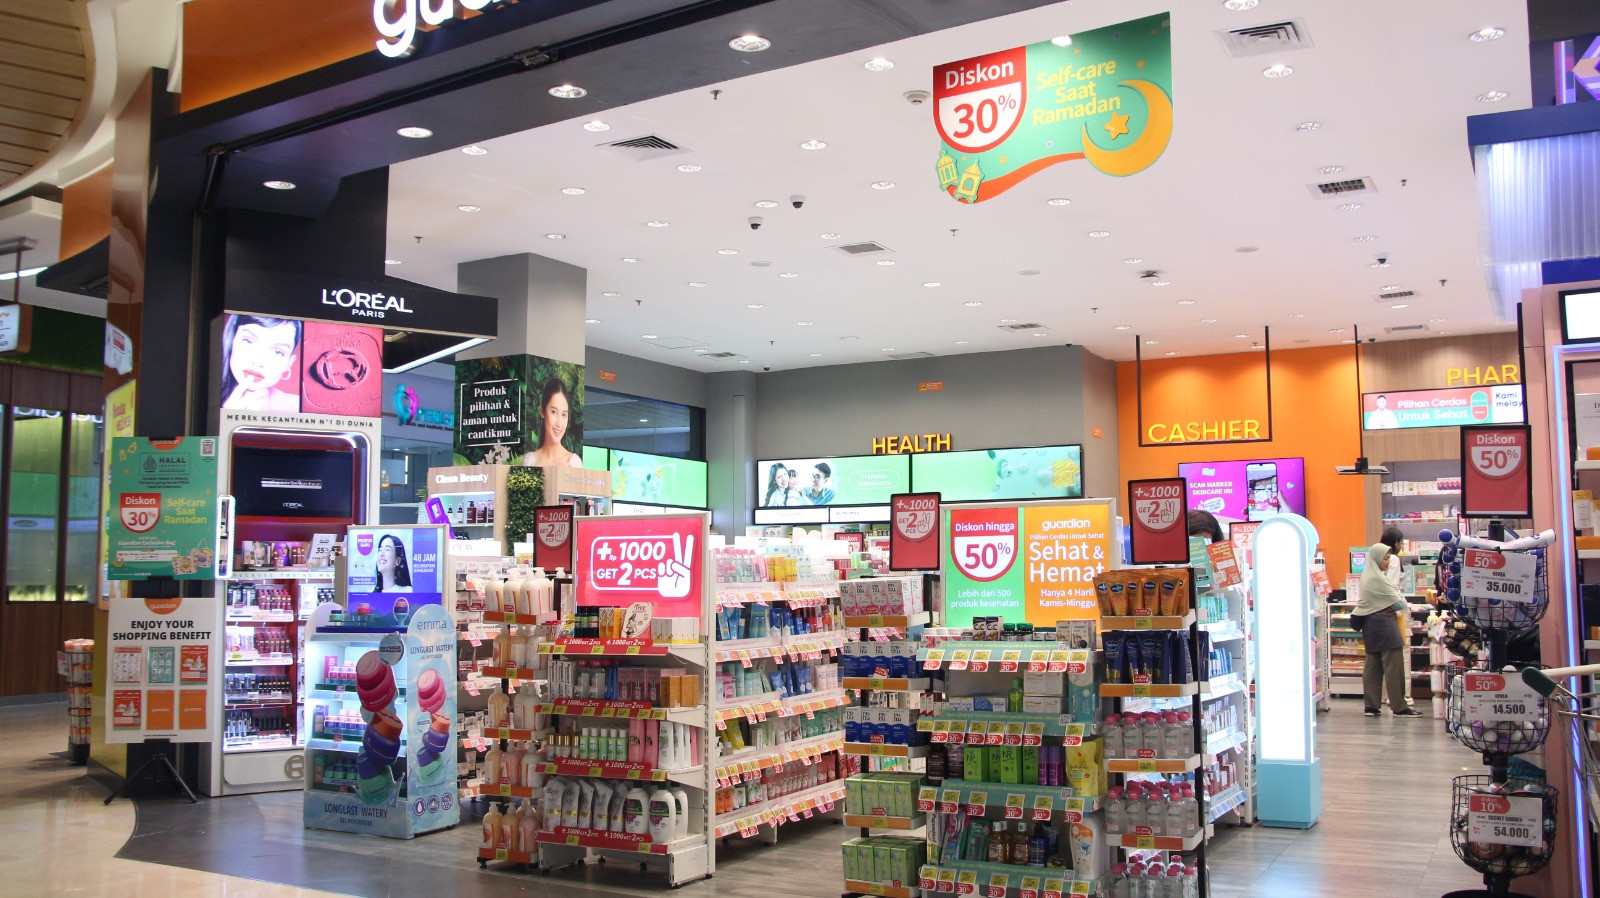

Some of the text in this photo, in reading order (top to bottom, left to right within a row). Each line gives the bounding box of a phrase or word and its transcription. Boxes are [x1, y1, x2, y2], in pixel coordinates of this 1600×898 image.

[945, 61, 1014, 90] Diskon
[1035, 60, 1117, 90] Self-care
[1055, 80, 1096, 104] Saat
[952, 92, 1016, 139] 30%
[1032, 96, 1121, 126] Ramadan
[322, 288, 414, 314] L'ORÉAL
[352, 308, 385, 318] PARIS
[474, 386, 507, 398] Produk
[470, 399, 510, 413] pilihan &
[1398, 397, 1468, 409] Pilihan Cerdas
[462, 416, 488, 426] aman
[490, 413, 518, 423] untuk
[1398, 410, 1468, 420] Untuk Sehat
[468, 429, 511, 439] cantikmu
[1148, 419, 1260, 442] CASHIER
[872, 433, 952, 454] HEALTH
[1476, 434, 1516, 445] Diskon
[1480, 449, 1518, 469] 50%
[436, 474, 458, 483] Clean
[1150, 486, 1180, 498] 1000
[125, 496, 156, 505] Diskon
[167, 498, 205, 507] Self-care
[909, 499, 936, 509] 1000
[176, 507, 196, 515] Saat
[1148, 501, 1160, 518] 2
[128, 510, 156, 526] 30%
[164, 515, 207, 524] Ramadan
[548, 512, 569, 521] 1000
[906, 513, 918, 528] 2
[546, 524, 555, 537] 2
[955, 522, 1015, 532] Diskon hingga
[1042, 518, 1090, 531] guardian
[619, 541, 666, 560] 1000
[964, 542, 1011, 569] 50%
[1029, 540, 1104, 561] Sehat &
[1474, 556, 1496, 567] 50%
[596, 562, 657, 585] GET 2 PCS
[1030, 562, 1105, 582] Hemat
[1041, 589, 1065, 598] Hanya
[1075, 588, 1094, 596] Hari!
[1487, 581, 1521, 594] 35.000
[951, 599, 1019, 609] produk kesehatan
[1040, 599, 1096, 608] Kamis-Minggu
[131, 620, 194, 630] ENJOY YOUR
[417, 620, 447, 630] emina
[113, 631, 211, 640] SHOPPING BENEFIT
[410, 645, 434, 654] LONGLAST
[1476, 681, 1496, 690] 50%
[1492, 704, 1526, 714] 14.500
[324, 803, 387, 818] LONGLAST WATERY
[1480, 802, 1501, 812] 10%
[1494, 826, 1528, 838] 54.000
